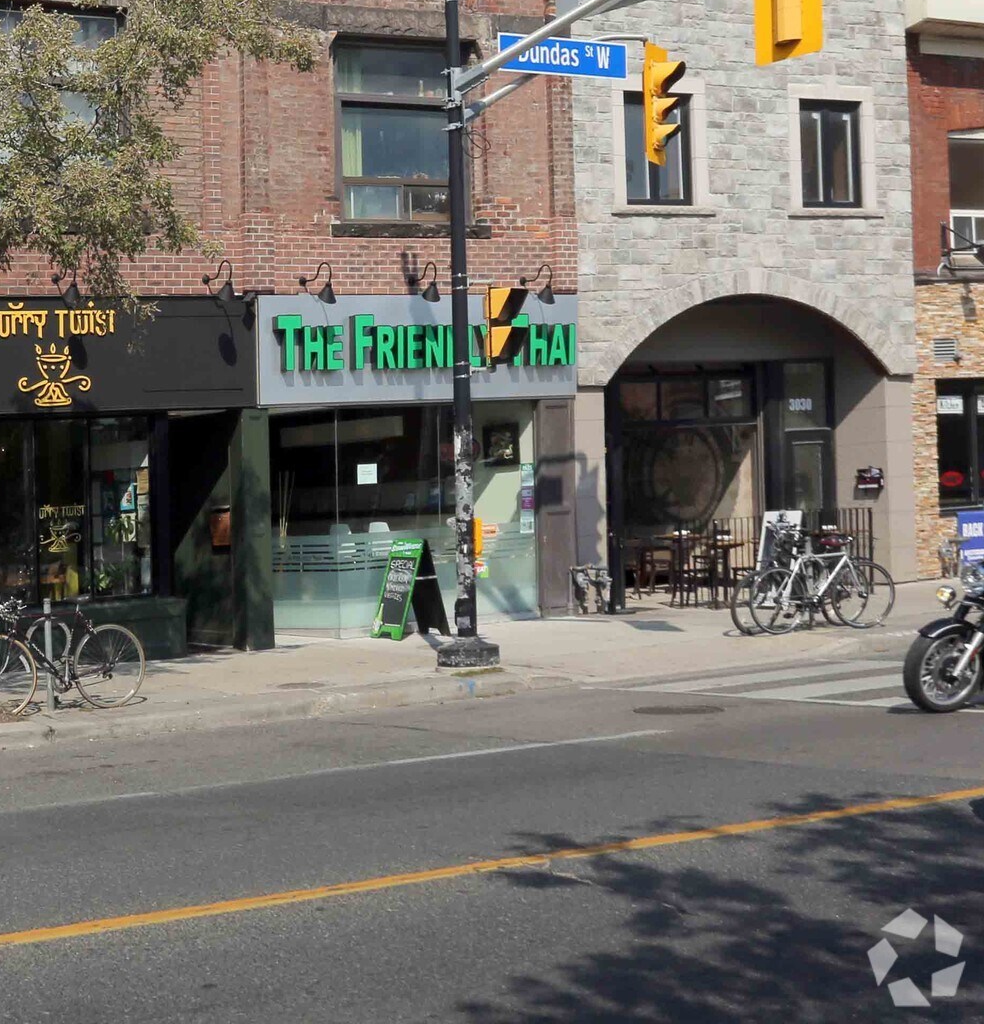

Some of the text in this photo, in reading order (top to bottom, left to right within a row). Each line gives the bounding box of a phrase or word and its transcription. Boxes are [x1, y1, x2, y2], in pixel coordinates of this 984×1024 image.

[585, 45, 594, 57] St
[596, 46, 610, 69] W
[272, 314, 344, 371] THE
